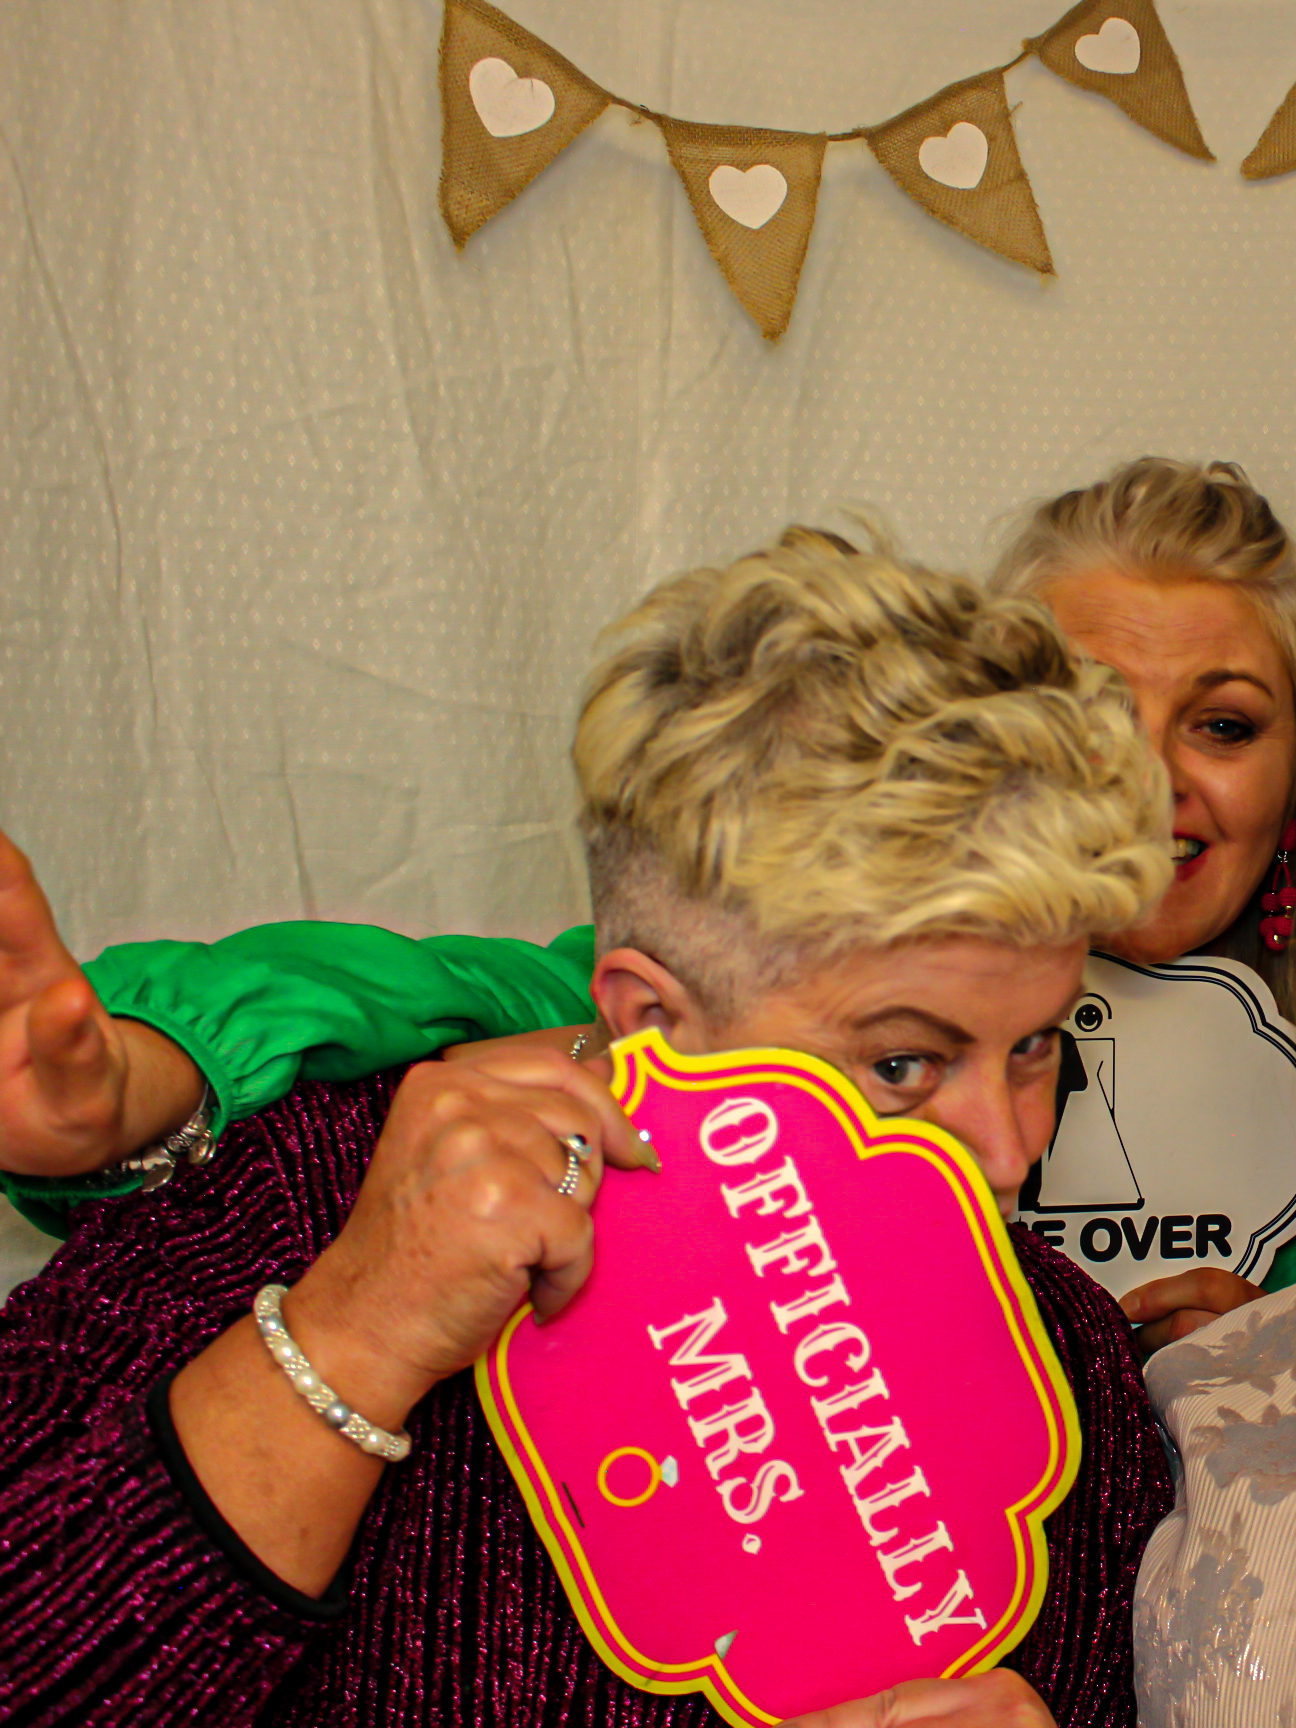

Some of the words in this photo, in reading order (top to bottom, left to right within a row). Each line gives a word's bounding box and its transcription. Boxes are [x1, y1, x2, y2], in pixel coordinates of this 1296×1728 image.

[1079, 1213, 1233, 1263] OVER
[647, 1296, 804, 1556] MRS.
[699, 1096, 987, 1647] OFFICIALLY
